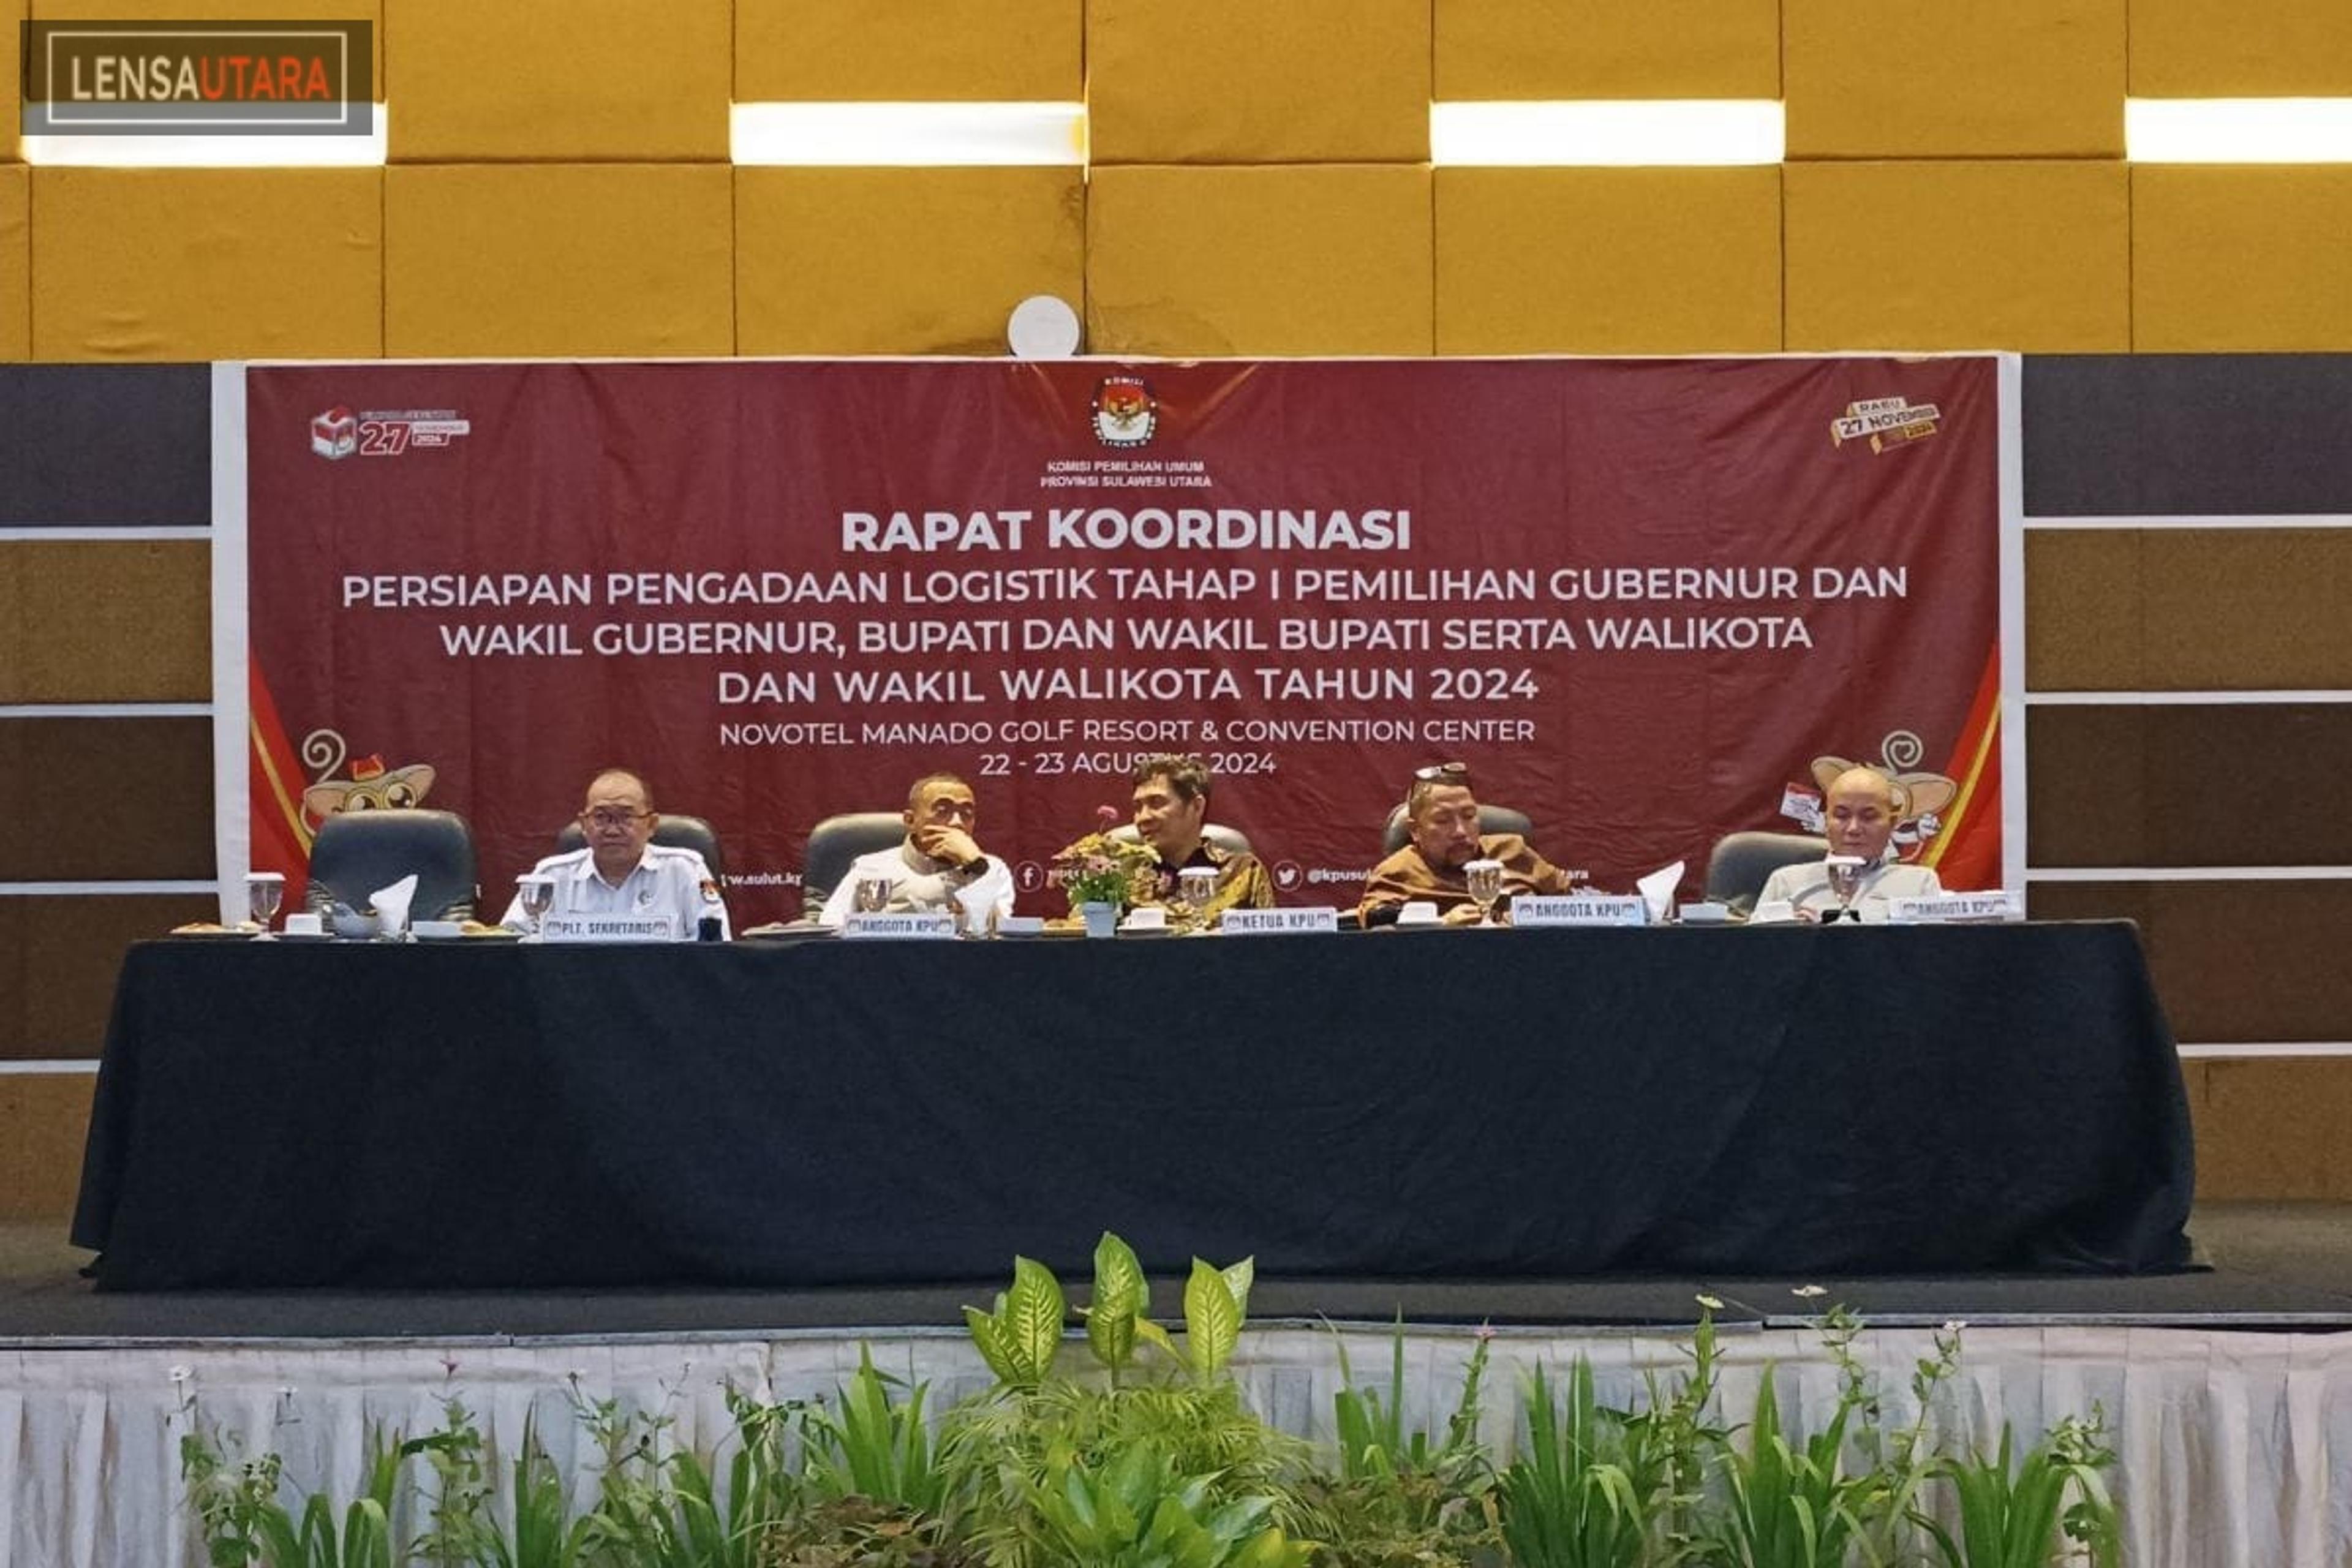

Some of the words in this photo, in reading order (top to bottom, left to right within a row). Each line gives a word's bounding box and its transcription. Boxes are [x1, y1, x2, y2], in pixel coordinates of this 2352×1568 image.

[360, 421, 411, 456] 27
[1841, 419, 1863, 435] 27
[1047, 460, 1091, 473] KOMISI
[1094, 461, 1162, 472] PEMILIHAN
[1165, 461, 1204, 472] UMUM
[1040, 476, 1099, 488] PROVINSI
[1102, 476, 1167, 487] SULAWESI
[1169, 475, 1212, 487] UTARA
[843, 511, 1032, 552] RAPAT
[1049, 508, 1410, 550] KOORDINASI
[343, 574, 591, 607] PERSIAPAN
[608, 571, 887, 605] PENGADAAN
[903, 568, 1098, 603] LOGISTIK
[1107, 568, 1256, 600] TAHAP
[1271, 569, 1279, 600] I
[1295, 569, 1535, 601] PEMILIHAN
[1550, 567, 1798, 600] GUBERNUR
[1813, 566, 1906, 598] DAN
[439, 624, 583, 656] WAKIL
[593, 621, 846, 659] GUBERNUR,
[859, 620, 1009, 652] BUPATI
[1023, 617, 1114, 650] DAN
[1126, 618, 1268, 650] WAKIL
[1280, 619, 1430, 650] BUPATI
[1442, 619, 1577, 650] SERTA
[1586, 617, 1813, 649] WALIKOTA
[719, 671, 815, 703] DAN
[833, 671, 986, 703] WAKIL
[1000, 668, 1242, 701] WALIKOTA
[1254, 668, 1413, 700] TAHUN
[1430, 668, 1539, 699] 2024
[720, 723, 854, 745] NOVOTEL
[862, 722, 993, 744] MANADO
[1000, 719, 1074, 742] GOLF
[1084, 719, 1194, 742] RESORT
[1200, 720, 1219, 742] &
[1226, 720, 1414, 742] CONVENTION
[1423, 720, 1535, 742] CENTER
[980, 753, 1011, 775] 22
[1035, 752, 1065, 774] 23
[1210, 752, 1276, 774] 2024
[1242, 914, 1283, 928] KETUA
[1289, 913, 1315, 927] KPU
[1596, 903, 1621, 916] KPU
[917, 919, 938, 932] KPU
